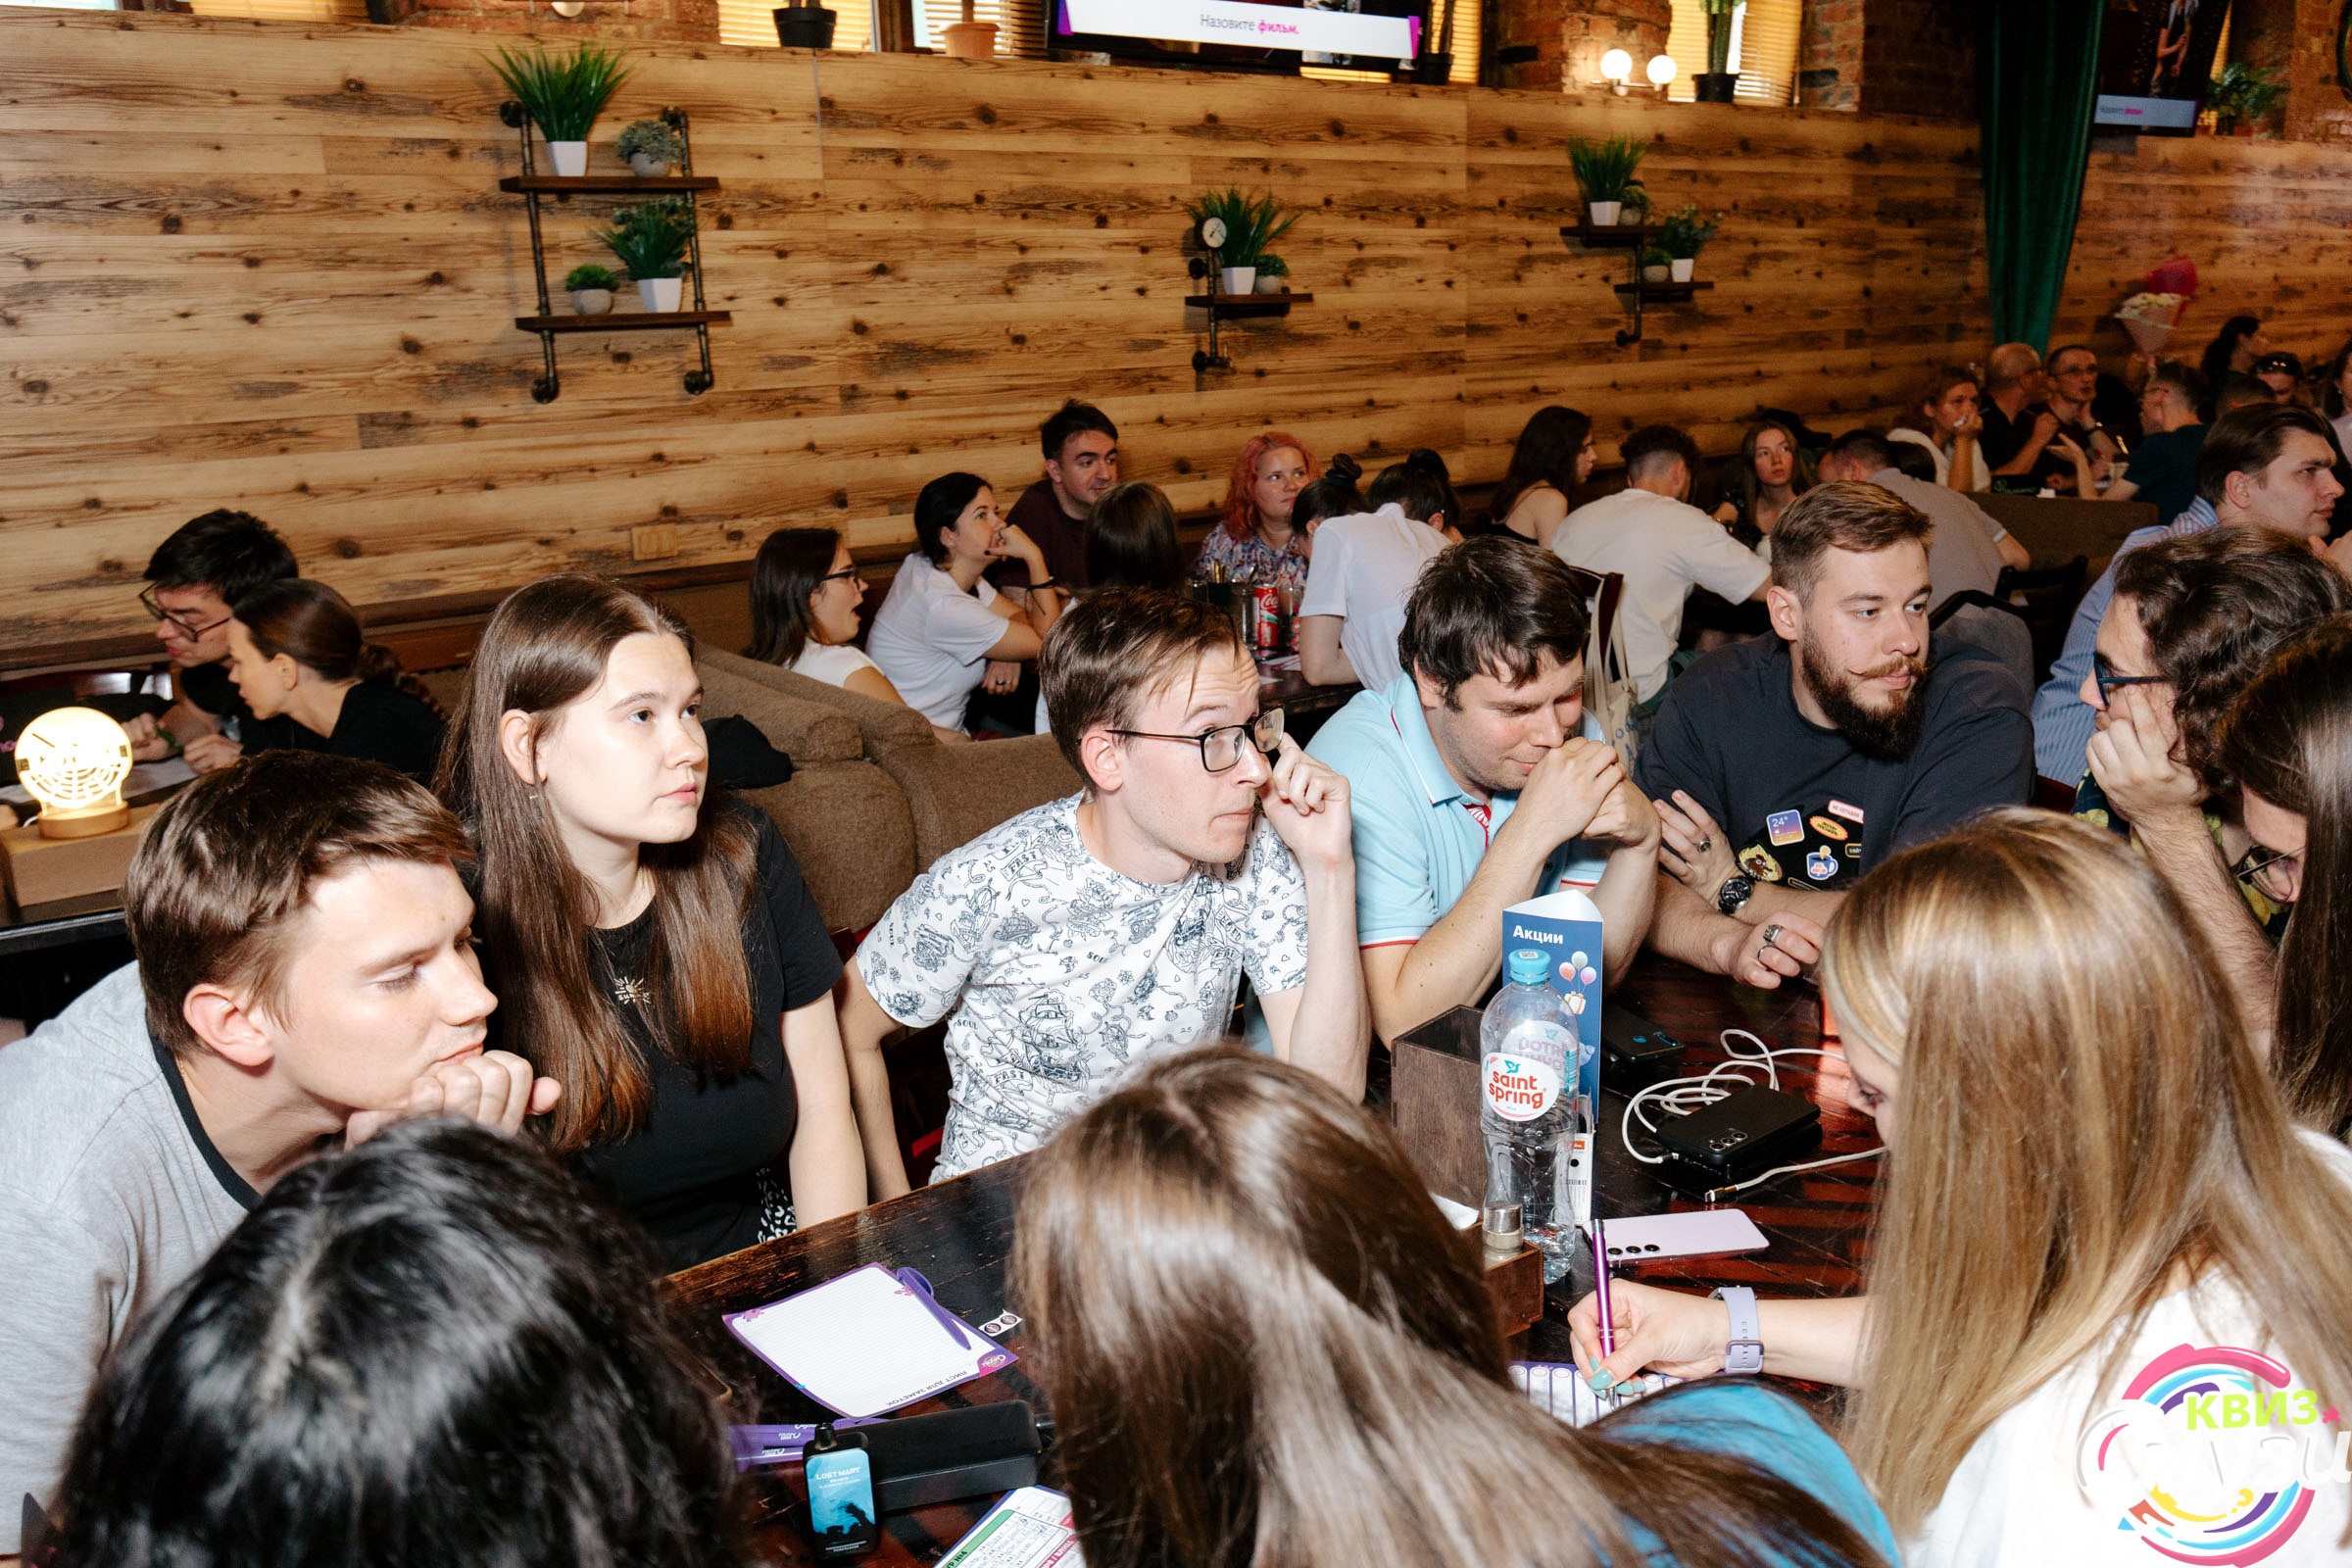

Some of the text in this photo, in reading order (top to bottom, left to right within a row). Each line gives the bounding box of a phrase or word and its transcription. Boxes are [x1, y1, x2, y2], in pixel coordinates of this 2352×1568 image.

[1200, 14, 1300, 34] Назовите фильм.
[1007, 852, 1038, 875] FAST
[1512, 924, 1564, 945] Акции
[956, 1018, 979, 1031] SOUL
[995, 1069, 1026, 1083] FAST
[1493, 1070, 1538, 1091] saint
[1489, 1082, 1544, 1110] spring
[926, 1380, 944, 1391] ДЛЯ
[885, 1388, 926, 1407] ЗАМЕТОК
[815, 1471, 837, 1481] LOST
[839, 1465, 861, 1477] MARY
